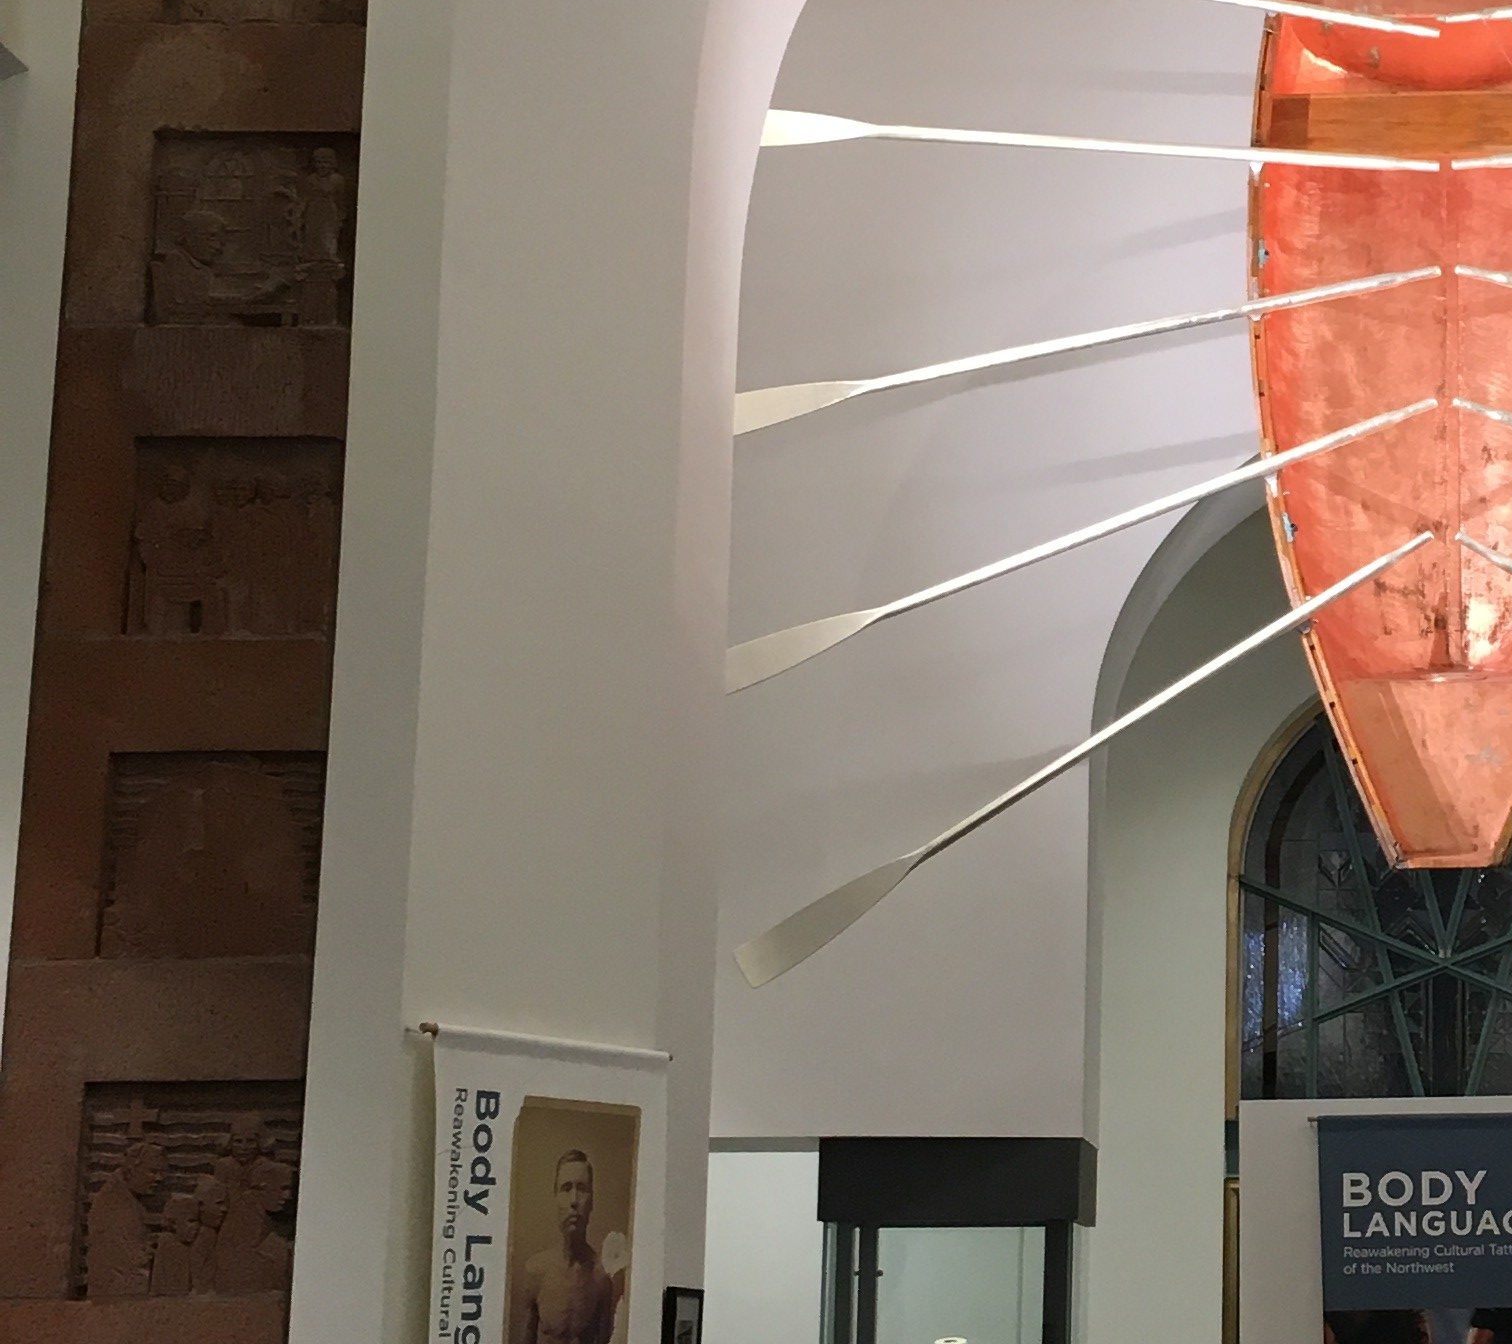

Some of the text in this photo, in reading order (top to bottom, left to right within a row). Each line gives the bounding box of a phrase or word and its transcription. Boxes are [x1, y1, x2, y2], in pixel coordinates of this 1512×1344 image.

[442, 1087, 469, 1240] Reawakening
[463, 1089, 501, 1216] Body
[1342, 1169, 1487, 1207] BODY
[1343, 1244, 1430, 1259] Reawakening
[1434, 1243, 1485, 1256] Cultural
[1343, 1261, 1454, 1275] of the Northwest
[438, 1247, 456, 1338] Cultural
